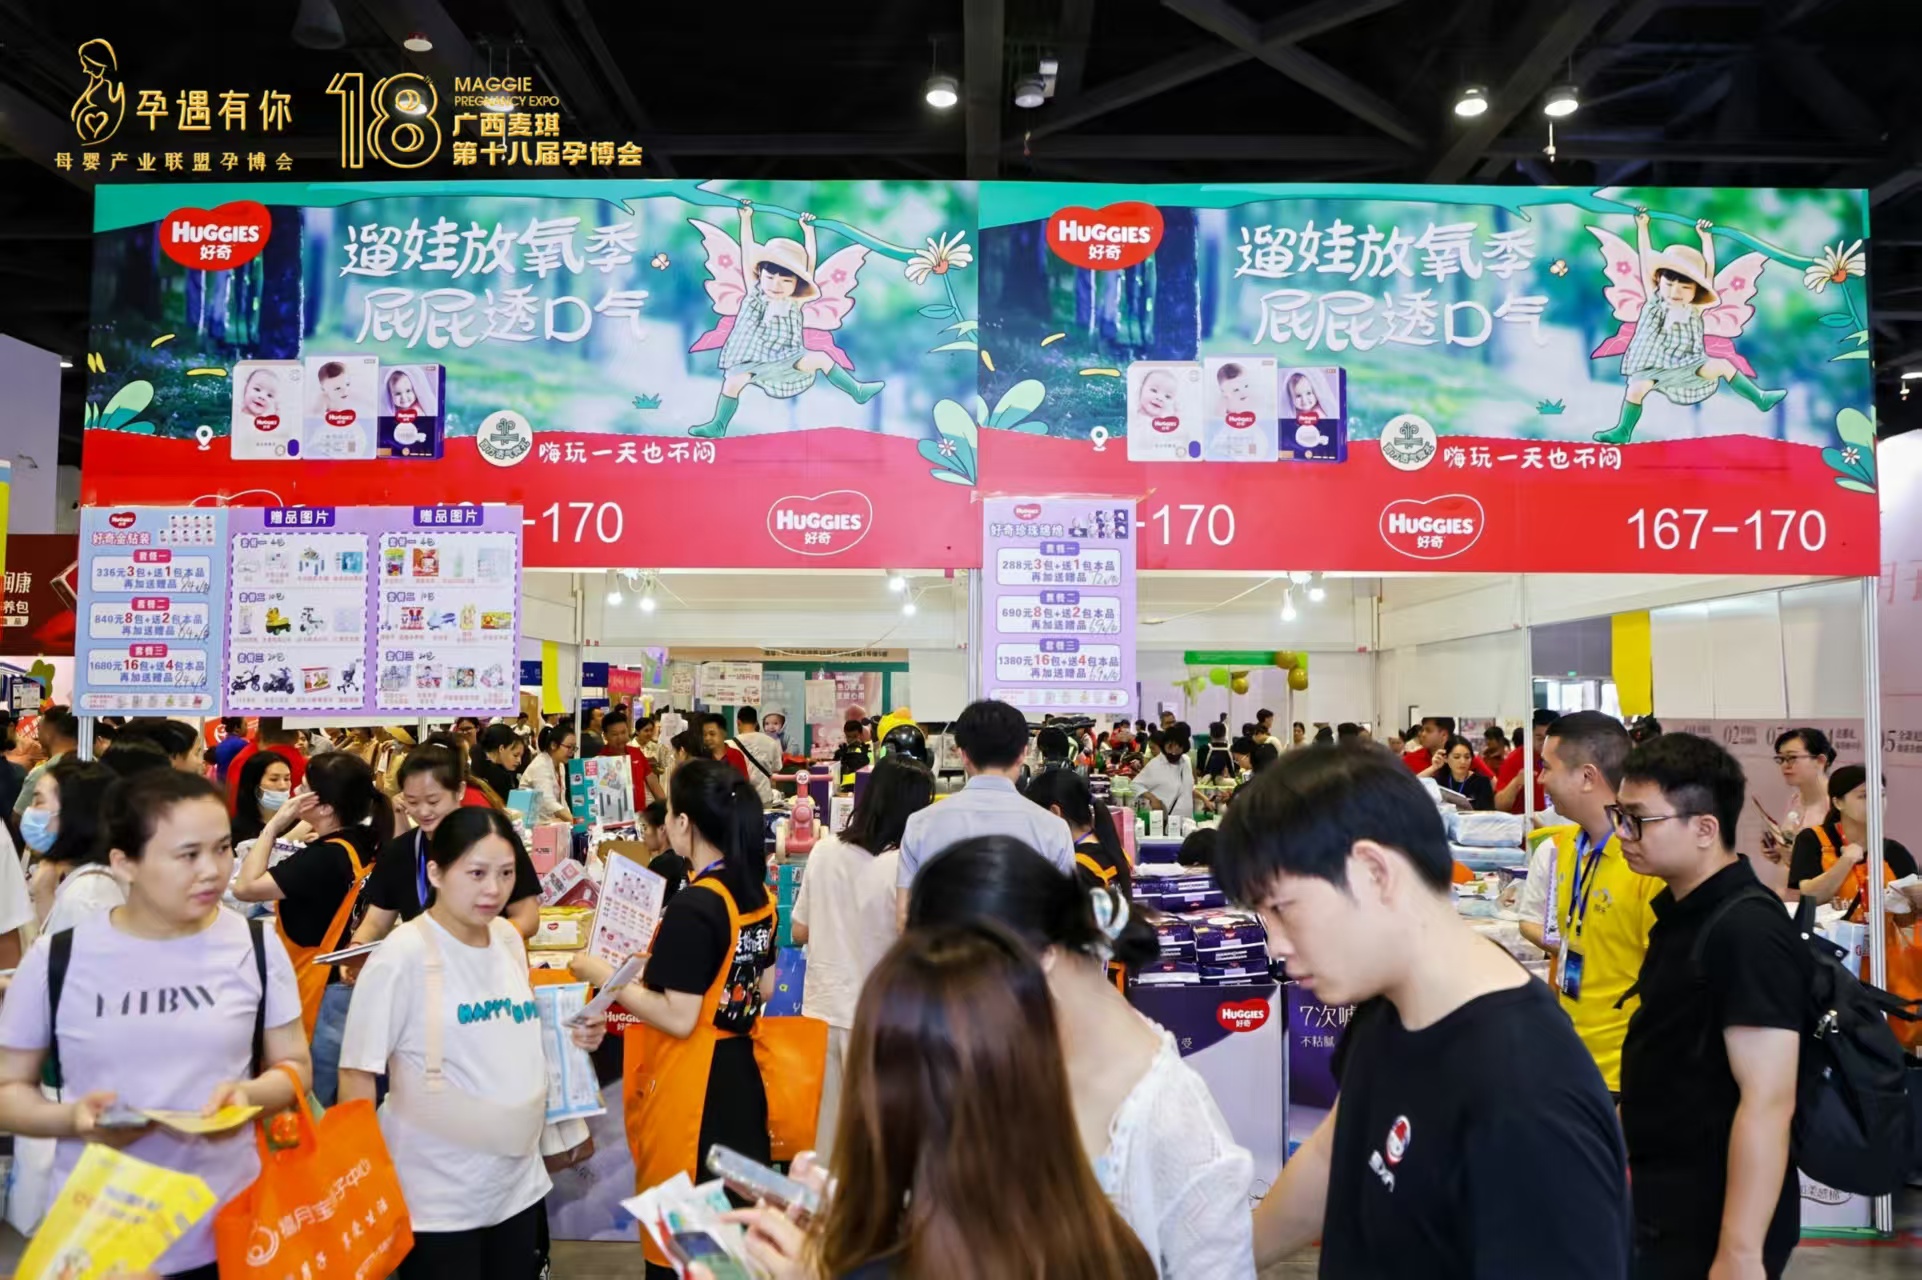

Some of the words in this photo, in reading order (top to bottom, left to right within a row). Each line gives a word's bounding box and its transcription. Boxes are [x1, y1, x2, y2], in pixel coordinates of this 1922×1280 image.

[172, 221, 260, 243] HUGGIES
[1059, 222, 1151, 243] HUGGIES
[200, 244, 232, 261] 好奇
[339, 215, 638, 279] 遛娃放氧季
[1088, 244, 1122, 261] 好奇
[1234, 219, 1536, 282] 遛娃放氧季
[355, 285, 650, 348] 屁屁透口气
[1252, 288, 1549, 351] 屁屁透口气
[538, 441, 716, 463] 嗨玩一天也不闷
[1443, 447, 1622, 470] 嗨玩一天也不闷
[270, 510, 329, 525] 赠品图片
[419, 509, 477, 524] 赠品图片
[777, 510, 862, 531] HUGGIES
[1389, 513, 1474, 535] HUGGIES
[1627, 508, 1826, 551] 167-170
[804, 532, 831, 546] 好奇
[1417, 536, 1445, 549] 好奇
[1002, 558, 1115, 571] 288元3包+送1包本品
[124, 579, 177, 589] 再加送赠品
[1031, 572, 1087, 583] 再加送赠品
[1002, 606, 1115, 619] 690元8包+送2包本品
[121, 625, 175, 636] 再加送赠品
[1031, 619, 1087, 631] 再加送赠品
[998, 654, 1119, 667] 1380元16包+送4包本品
[120, 672, 173, 682] 再加送赠品
[1031, 668, 1087, 679] 再加送赠品
[1723, 726, 1740, 745] 02
[1222, 1008, 1264, 1020] HUGGIES
[1236, 1020, 1251, 1028] 好奇
